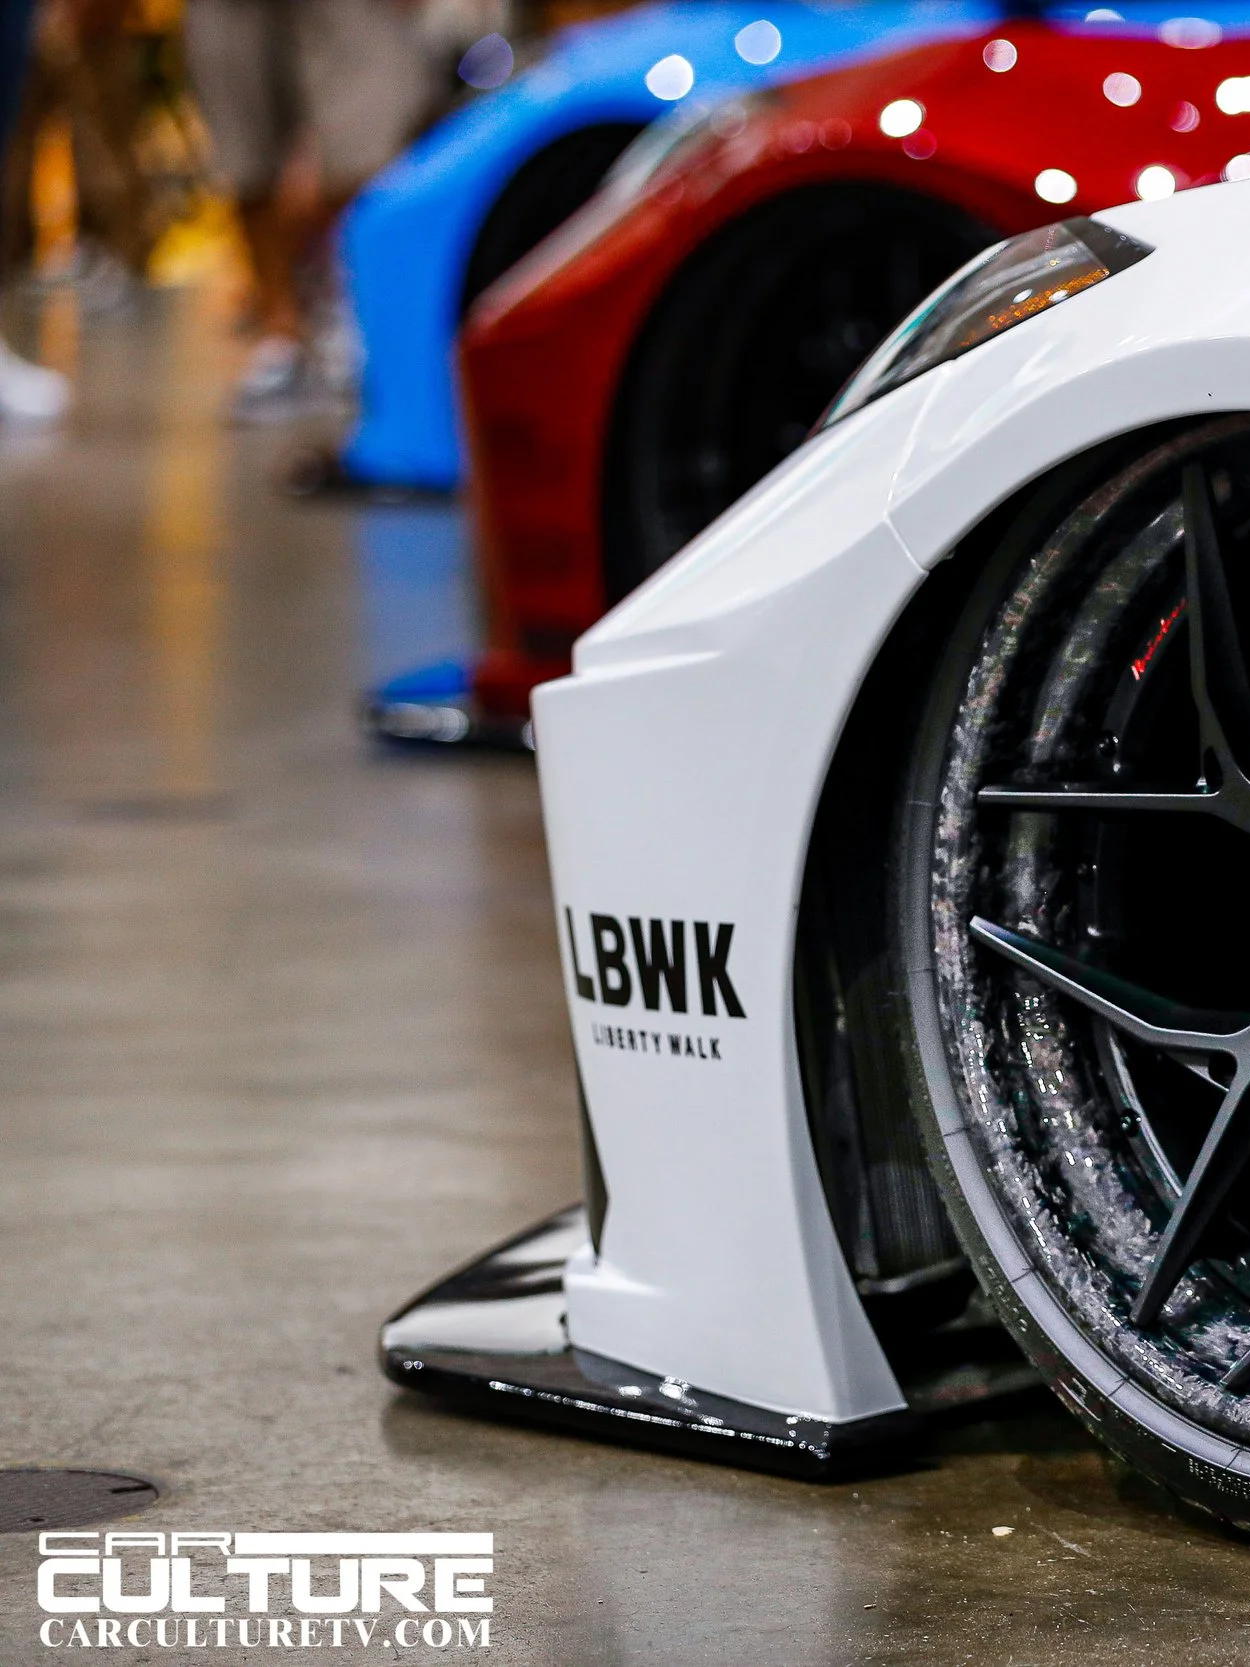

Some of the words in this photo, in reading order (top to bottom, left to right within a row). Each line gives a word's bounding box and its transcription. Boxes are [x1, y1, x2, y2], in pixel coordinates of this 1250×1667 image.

[565, 904, 748, 1019] LBWK
[592, 1023, 661, 1054] LIBERTY
[667, 1034, 722, 1060] WALK
